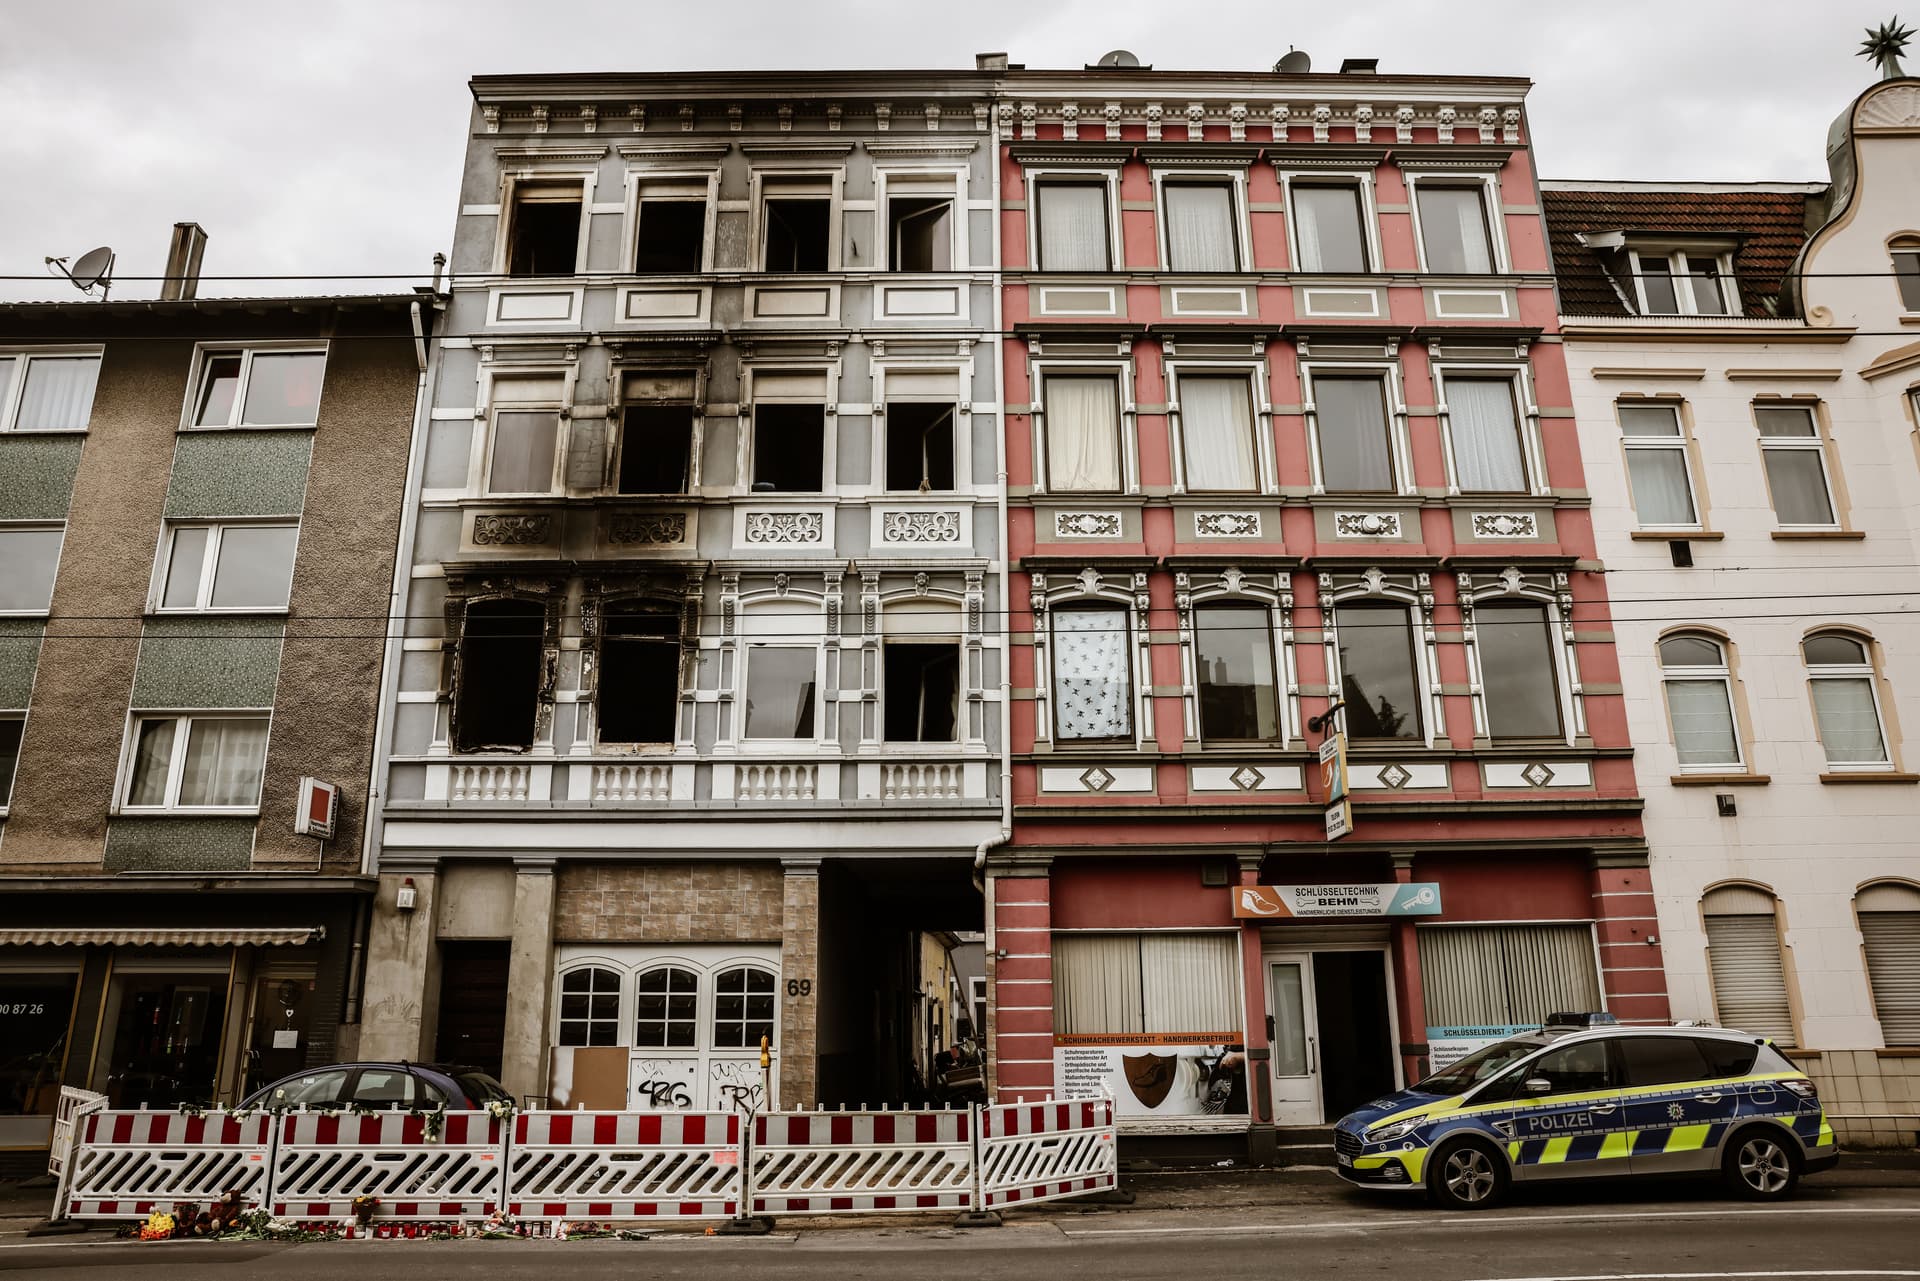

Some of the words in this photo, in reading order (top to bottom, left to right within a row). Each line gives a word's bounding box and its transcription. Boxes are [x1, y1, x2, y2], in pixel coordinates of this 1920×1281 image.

[1295, 885, 1379, 897] SCHLÜSSELTECHNIK
[1318, 898, 1358, 906] BEHM
[788, 979, 811, 996] 69
[12, 1004, 27, 1015] 87
[29, 1004, 44, 1015] 26
[1443, 1027, 1505, 1037] SCHLÜSSELDIENST
[1063, 1036, 1155, 1044] SCHUHMACHERWERKSTATT
[1163, 1035, 1235, 1043] HANDWERKSBETRIEB
[1528, 1112, 1593, 1131] POLIZEI
